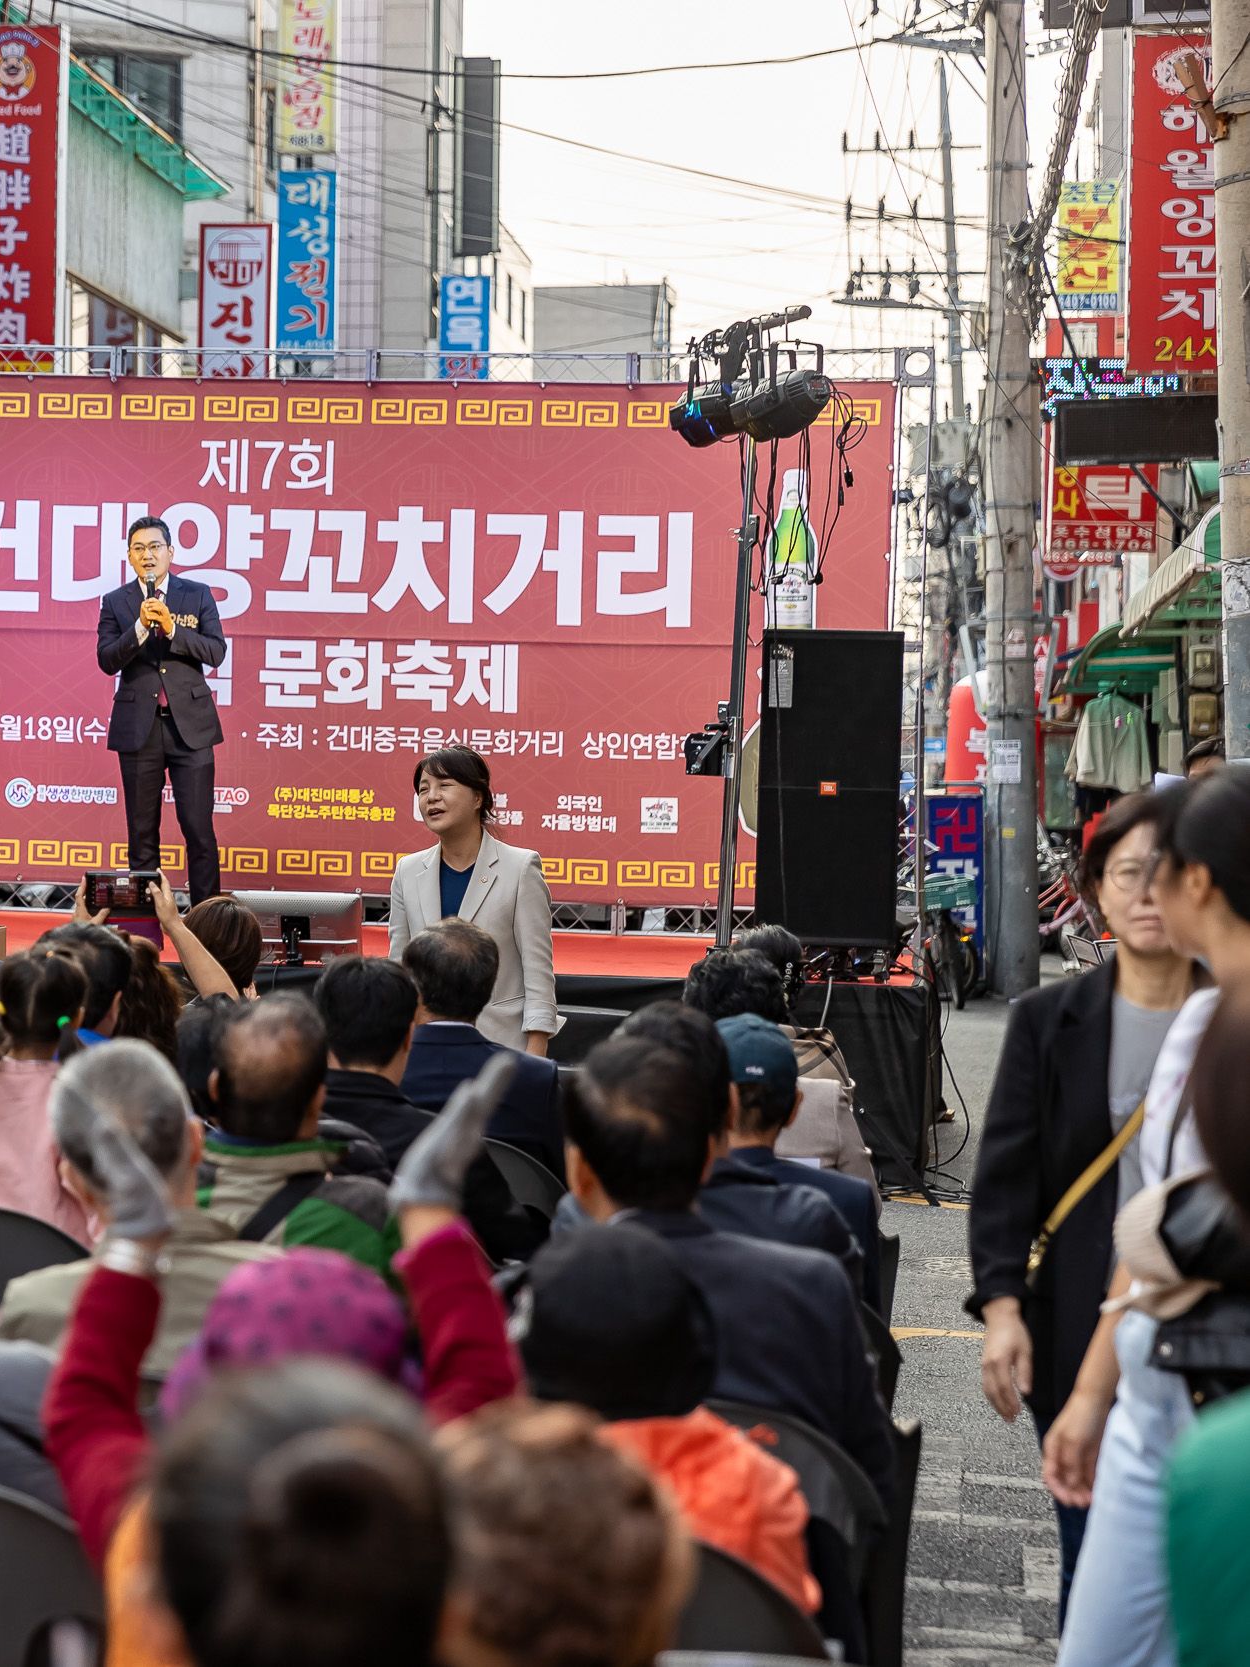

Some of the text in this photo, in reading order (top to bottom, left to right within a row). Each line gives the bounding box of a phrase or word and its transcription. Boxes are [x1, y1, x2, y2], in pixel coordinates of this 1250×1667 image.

[14, 103, 42, 116] Food
[284, 174, 330, 339] 대성전기
[198, 438, 336, 496] 제7회
[258, 638, 519, 714] 문화축제
[256, 723, 303, 750] 주최
[326, 725, 564, 757] 건대중국음식문화거리
[48, 787, 115, 802] 생생한방병원
[557, 795, 603, 812] 외국인
[541, 814, 617, 833] 자율방범대
